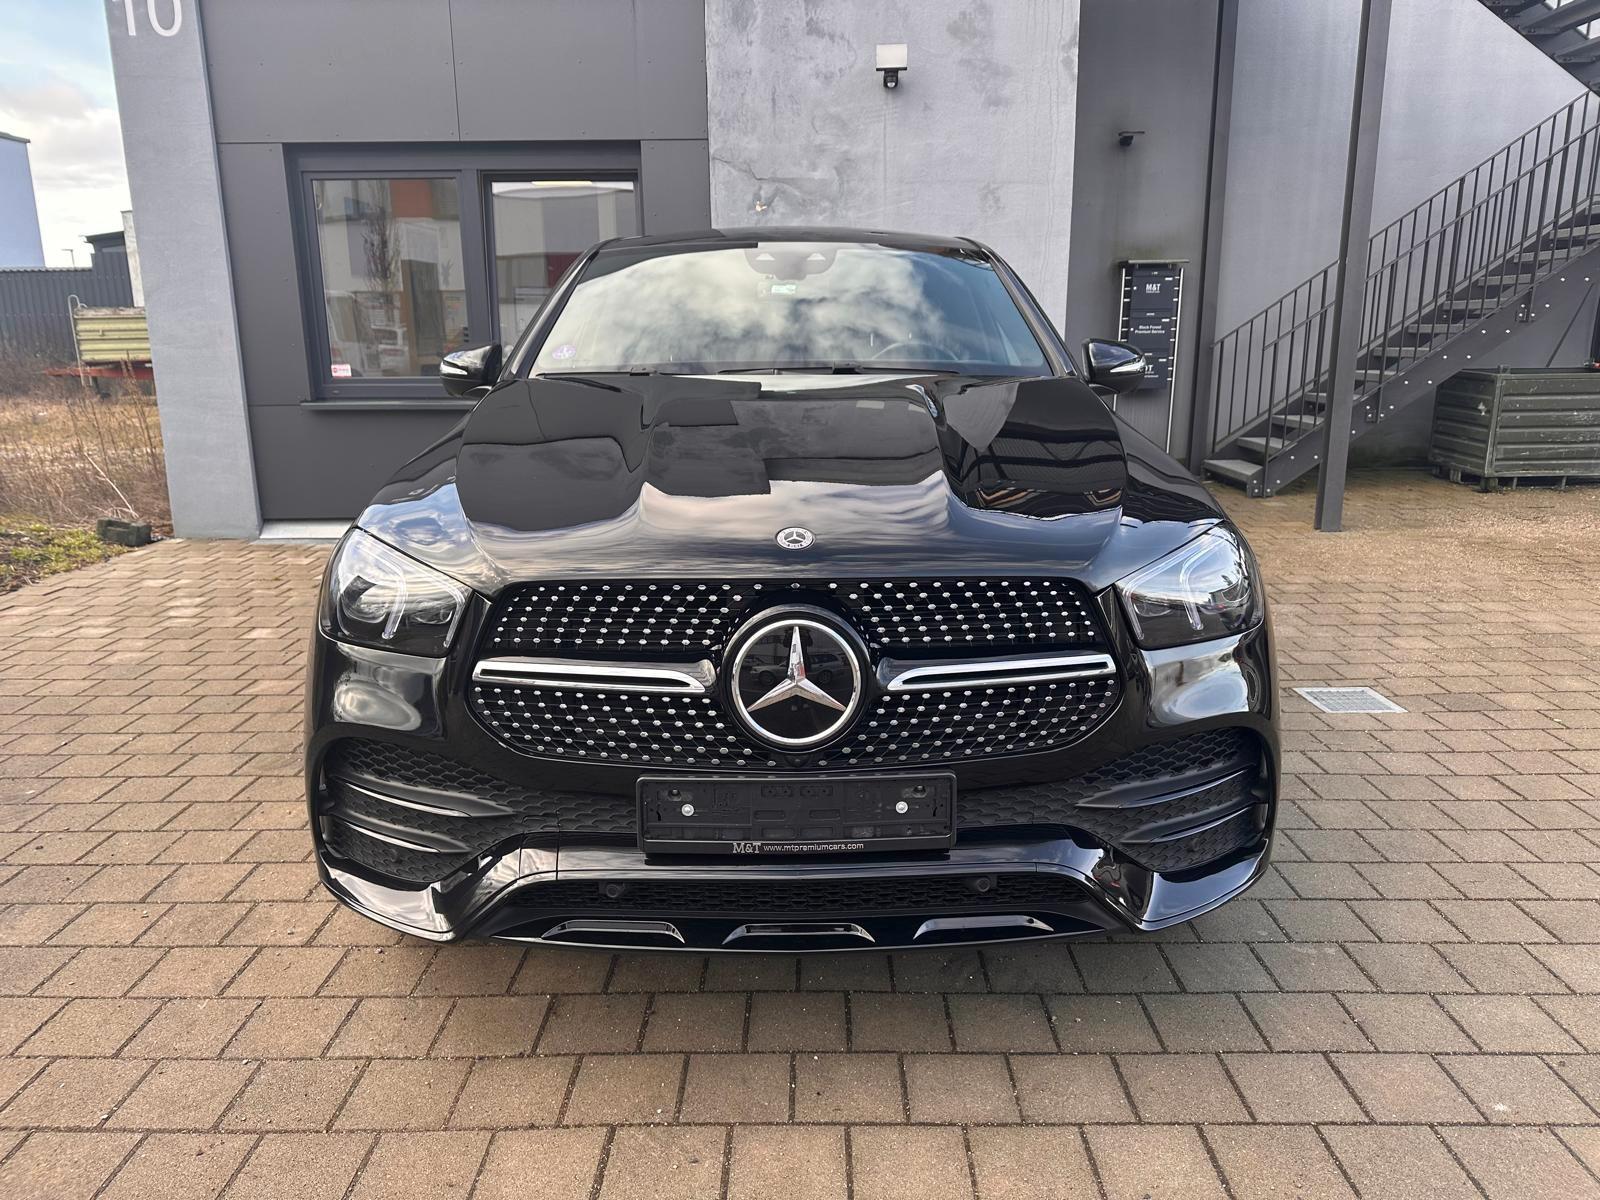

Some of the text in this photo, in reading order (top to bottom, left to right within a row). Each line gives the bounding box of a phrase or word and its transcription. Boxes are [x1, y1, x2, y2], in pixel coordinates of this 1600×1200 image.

[112, 0, 182, 37] 10
[1145, 283, 1161, 291] M&T
[732, 842, 864, 854] M&T www.mtpremiumcars.com
